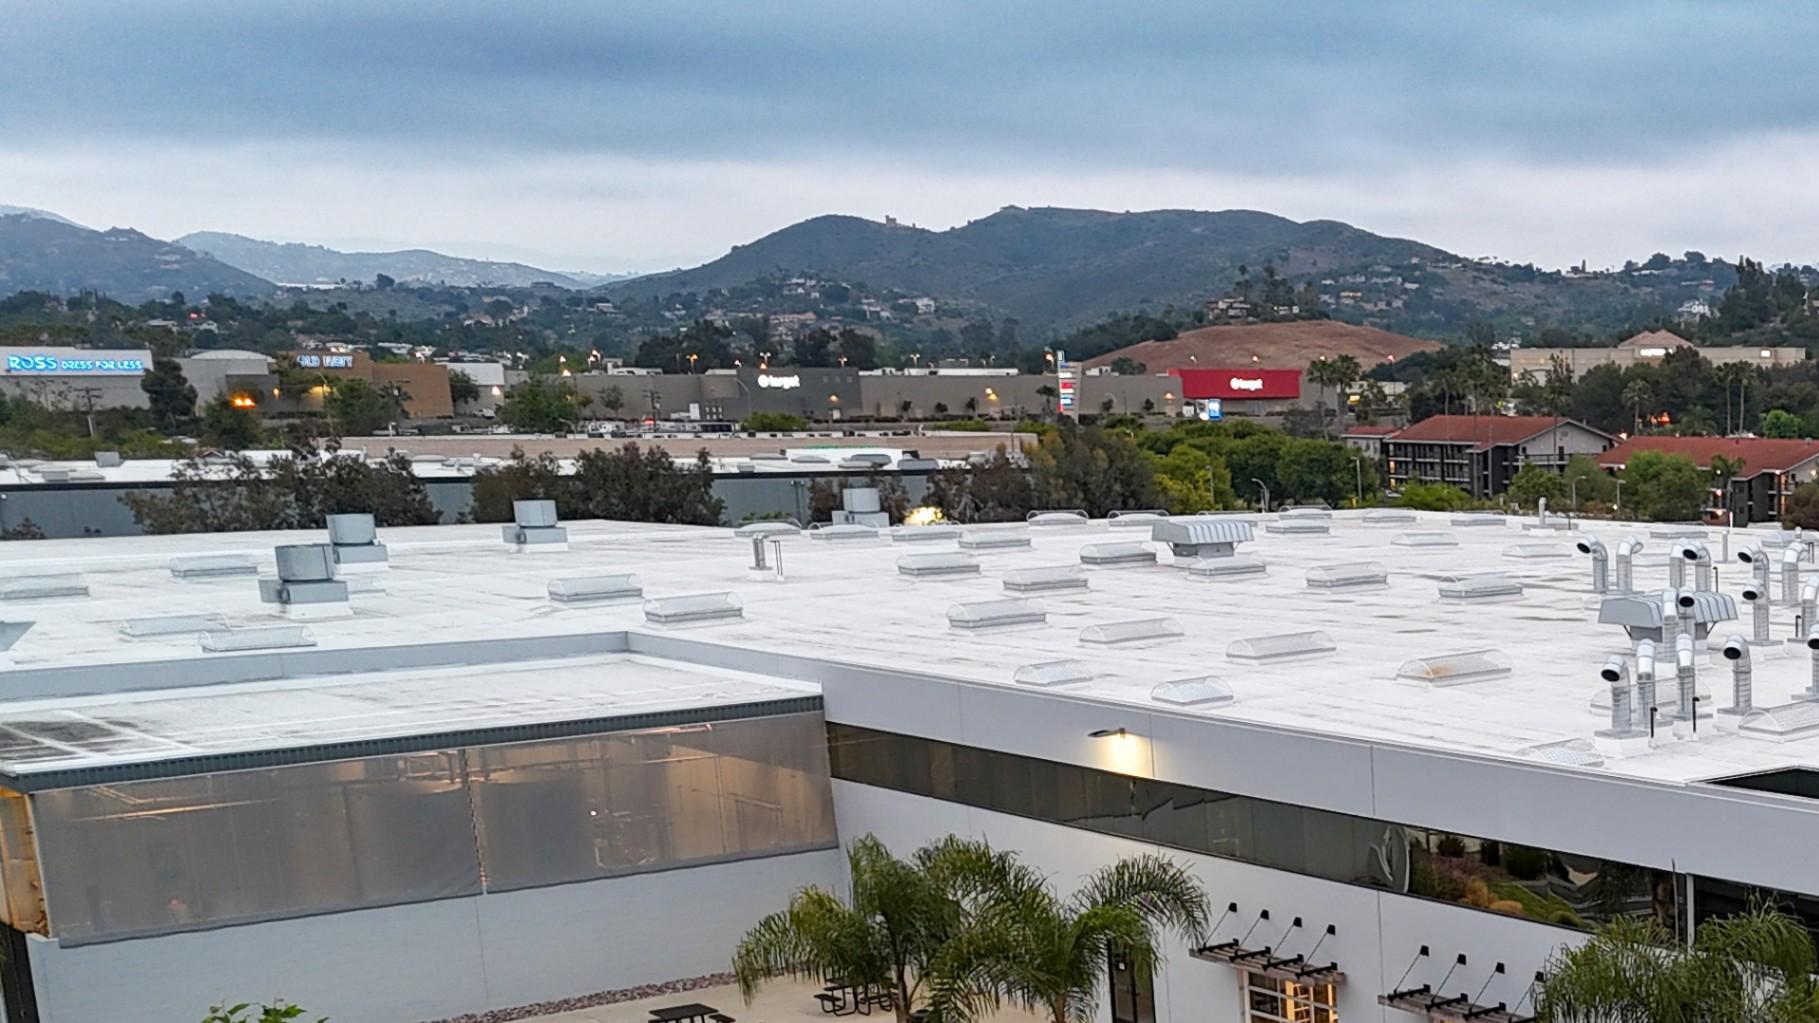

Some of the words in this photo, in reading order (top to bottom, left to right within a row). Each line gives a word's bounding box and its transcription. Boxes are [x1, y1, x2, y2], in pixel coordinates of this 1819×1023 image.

[8, 356, 57, 369] ROSS
[61, 360, 93, 369] DRESS
[95, 360, 115, 369] FOR
[117, 360, 142, 369] LESS
